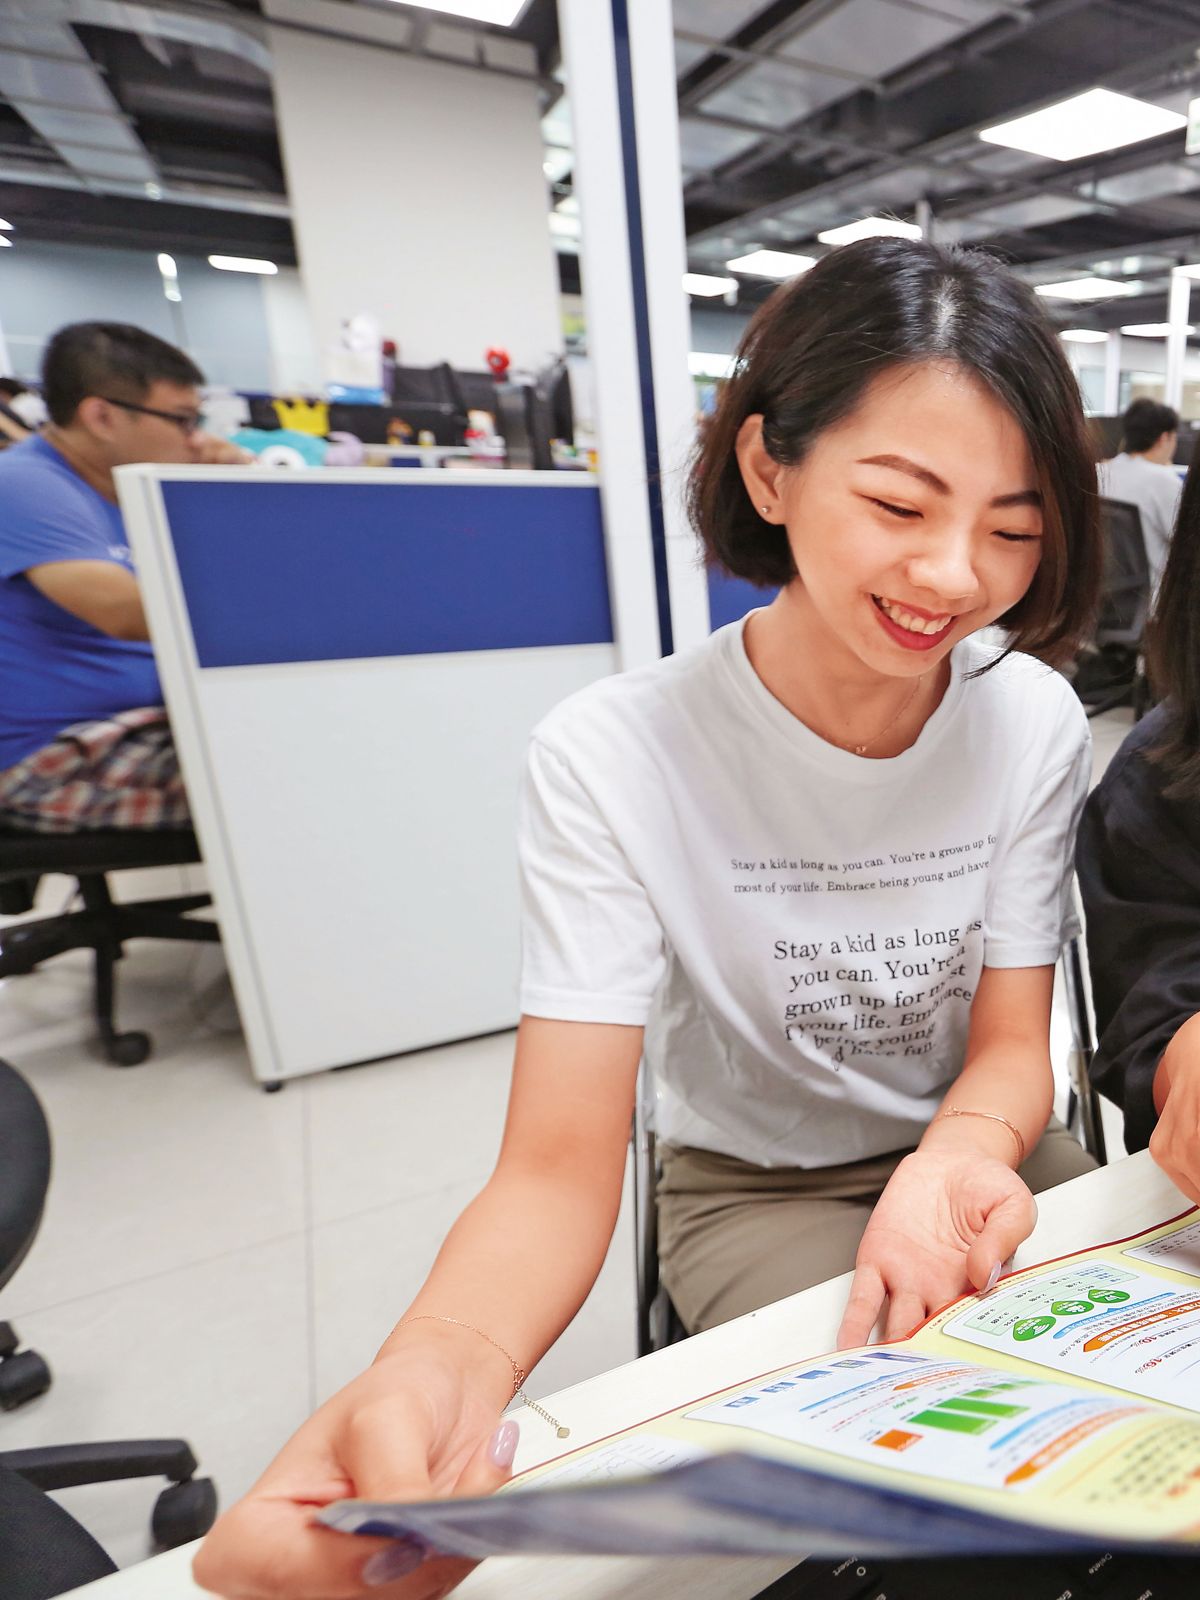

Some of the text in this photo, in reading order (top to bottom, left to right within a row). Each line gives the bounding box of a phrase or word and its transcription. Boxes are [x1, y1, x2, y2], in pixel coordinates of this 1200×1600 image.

[731, 859, 755, 872] Stay
[760, 861, 766, 870] a
[769, 859, 787, 870] kid
[801, 859, 824, 872] long
[842, 861, 862, 874] you
[864, 858, 885, 869] can.
[889, 850, 926, 865] You're
[929, 850, 936, 859] a
[938, 843, 971, 859] grown
[972, 839, 984, 850] up
[987, 834, 998, 845] fo
[734, 859, 990, 895] most of your life. Embrace being young and have
[773, 940, 822, 961] Stay
[830, 940, 841, 954] a
[845, 933, 876, 953] kid
[885, 936, 906, 950] as
[914, 928, 960, 948] long
[789, 969, 829, 992] you
[836, 968, 878, 982] can.
[785, 994, 851, 1020] grown
[859, 995, 885, 1010] up
[894, 990, 925, 1008] for
[853, 1014, 891, 1031] life.
